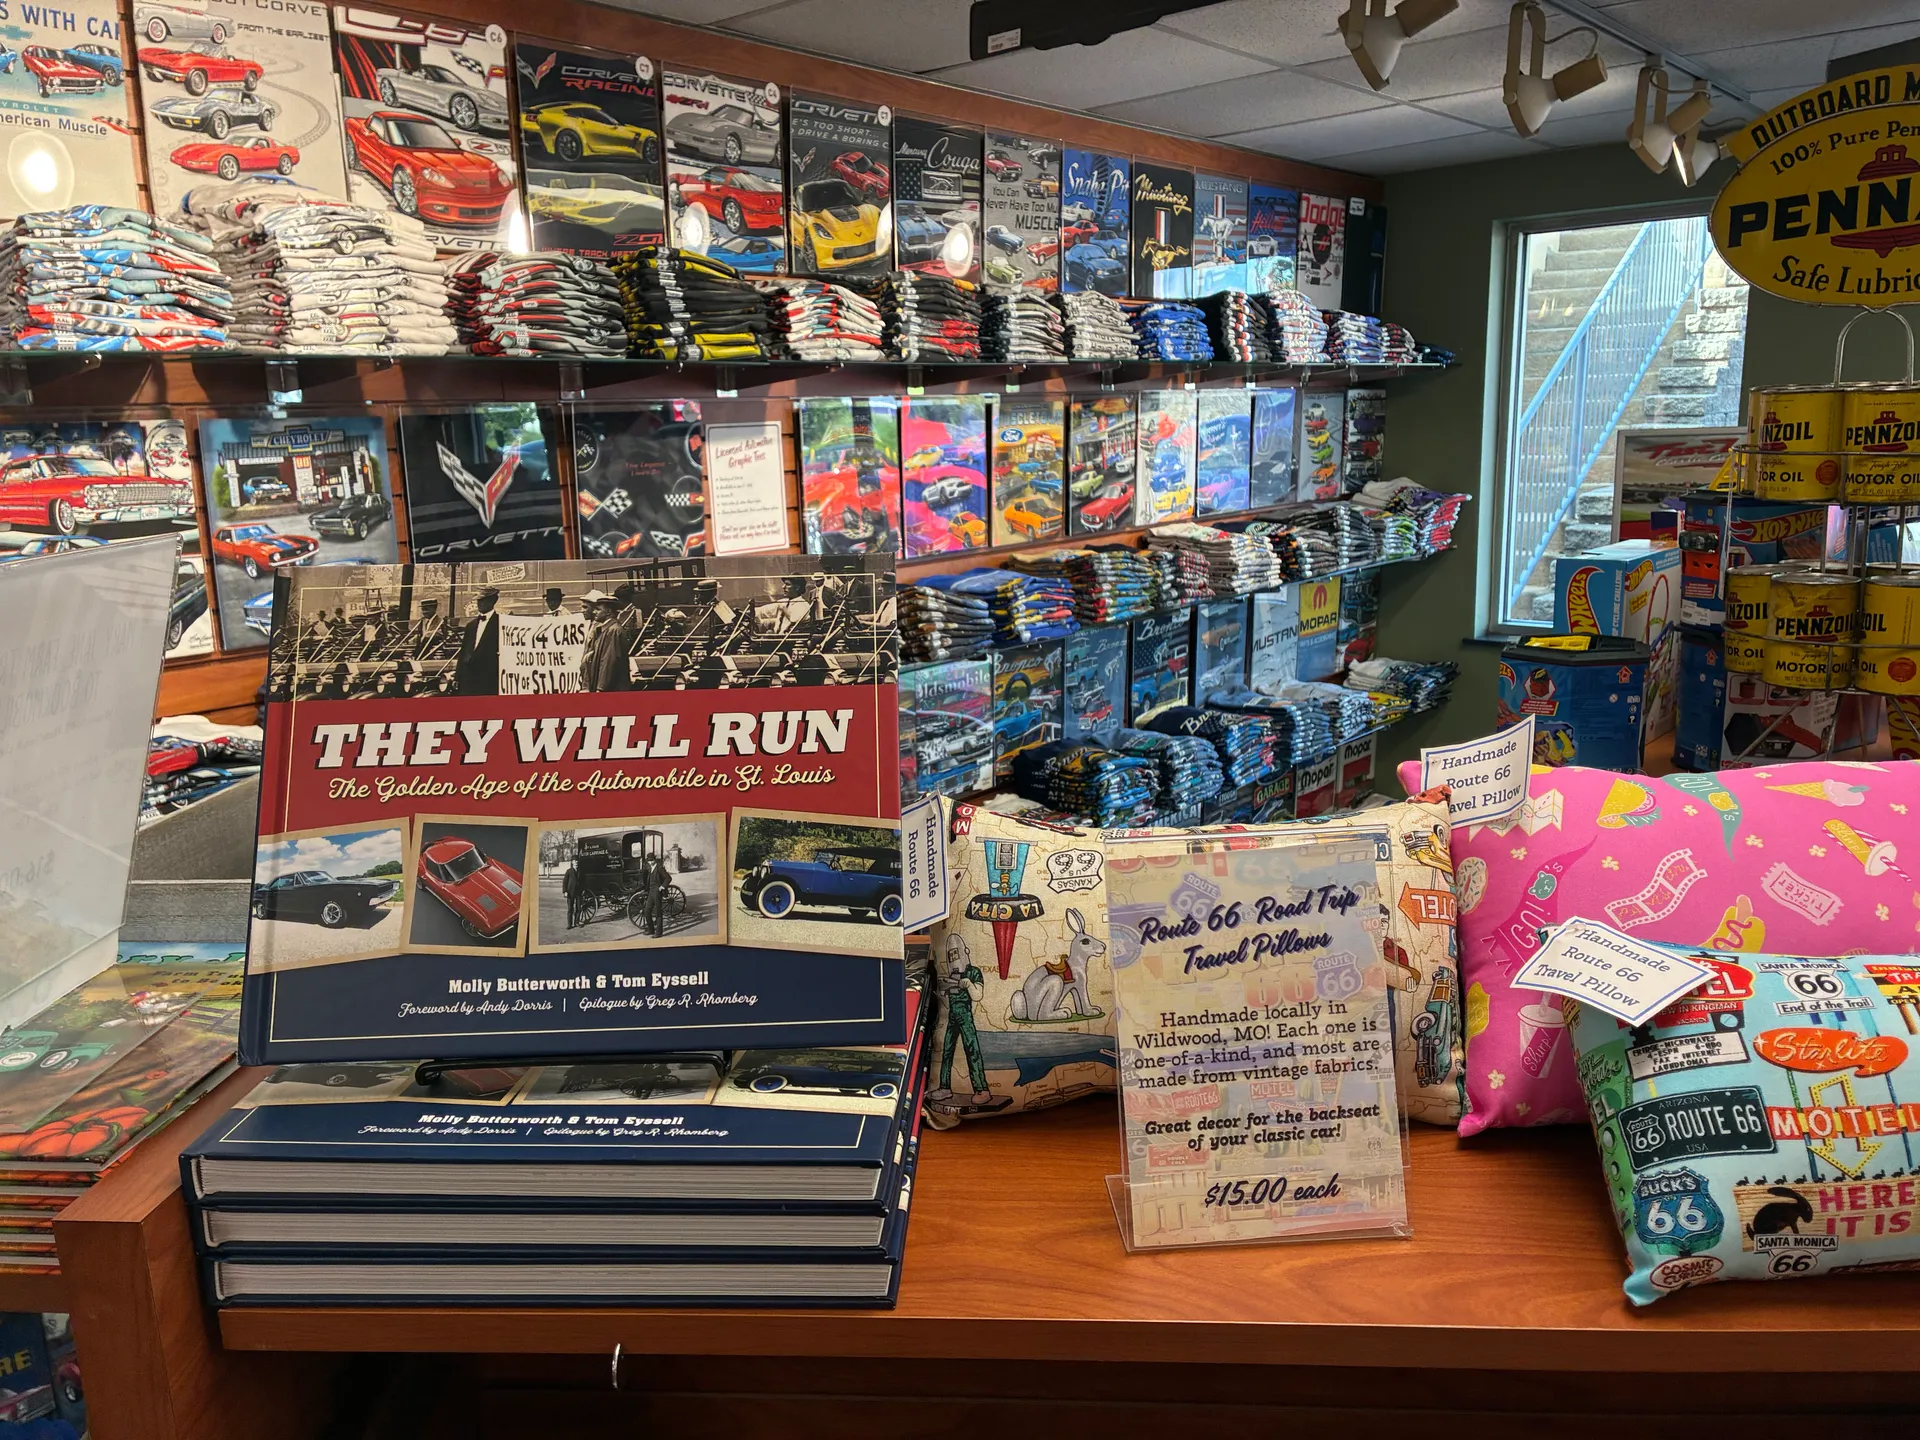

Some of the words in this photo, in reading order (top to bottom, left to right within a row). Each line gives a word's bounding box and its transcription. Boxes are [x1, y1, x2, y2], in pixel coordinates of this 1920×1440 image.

[21, 4, 76, 31] WITH
[237, 23, 264, 32] FROM
[266, 27, 283, 36] THE
[663, 73, 751, 102] CORVETTE
[1751, 75, 1890, 149] OUTBOARD
[58, 118, 108, 135] Muscle
[798, 129, 829, 139] DRIVE
[842, 136, 879, 147] BORING
[813, 121, 833, 130] TOO
[1770, 141, 1822, 175] 100%
[1829, 126, 1879, 151] Pure
[1006, 188, 1020, 197] Can
[1063, 162, 1105, 199] Snake
[1107, 169, 1130, 200] Pit
[1195, 180, 1243, 193] MUSTANG
[1010, 201, 1029, 211] Have
[1031, 202, 1045, 212] Too
[1727, 177, 1920, 248] PENN
[1772, 254, 1831, 292] Safe
[716, 441, 743, 458] Licensed
[1780, 471, 1804, 482] OIL
[1846, 473, 1895, 484] MOTOR
[1300, 612, 1337, 631] MOPAR
[502, 626, 531, 646] THESE
[532, 623, 552, 648] 14
[554, 623, 585, 645] CARS
[516, 652, 533, 666] SOLD
[536, 652, 545, 666] TO
[548, 652, 565, 666] THE
[1775, 660, 1826, 673] MOTOR
[1861, 661, 1878, 674] OIL
[501, 669, 519, 694] CITY
[522, 677, 529, 690] OF
[311, 720, 503, 768] THEY
[511, 714, 690, 763] WILL
[704, 709, 853, 757] RUN
[1344, 739, 1371, 760] Mopar
[1442, 741, 1517, 771] Handmade
[329, 777, 371, 799] The
[375, 775, 457, 803] Golden
[460, 774, 510, 800] Age
[513, 772, 537, 798] of
[539, 772, 573, 792] the
[577, 767, 706, 796] Automobile
[709, 769, 731, 787] in
[735, 764, 765, 792] St.
[771, 763, 835, 785] Louis
[1300, 763, 1334, 790] Mopar
[1447, 774, 1489, 790] Route
[1494, 765, 1511, 781] 66
[1256, 778, 1290, 803] GARAGE
[1482, 783, 1521, 807] Pillow
[908, 829, 918, 875] Route
[926, 815, 939, 899] Handmade
[910, 878, 920, 899] 66
[1057, 878, 1093, 889] KANSAS
[1778, 878, 1822, 911] TICKET
[970, 901, 1012, 920] CITA
[1139, 914, 1201, 945] Route
[1207, 902, 1242, 930] 66
[1255, 891, 1312, 924] Road
[1318, 884, 1361, 916] Trip
[1183, 939, 1247, 974] Travel
[1252, 928, 1334, 962] Pillows
[1575, 929, 1671, 973] Handmade
[1562, 946, 1612, 971] Route
[1615, 967, 1643, 983] 66
[448, 979, 492, 996] Molly
[497, 975, 591, 992] Butterworth
[596, 975, 607, 988] &
[612, 974, 646, 988] Tom
[651, 971, 709, 989] Eyssell
[1322, 968, 1355, 991] 66
[1534, 964, 1581, 983] Travel
[1580, 978, 1640, 1007] Pillow
[1794, 974, 1838, 994] 66
[398, 1001, 459, 1018] Foreword
[460, 1001, 474, 1016] by
[475, 999, 510, 1015] Andy
[511, 999, 553, 1012] Dorris
[579, 996, 628, 1012] Epilogue
[629, 996, 645, 1010] by
[645, 995, 676, 1010] Greg
[677, 993, 694, 1008] R.
[695, 992, 759, 1007] Rhomberg
[1160, 1008, 1259, 1028] Handmade
[1265, 1002, 1321, 1022] locally
[1328, 1000, 1348, 1016] in
[1691, 1003, 1737, 1011] KINGMAN
[1781, 1001, 1805, 1013] End
[1810, 1001, 1822, 1010] of
[1825, 1000, 1843, 1009] the
[1848, 998, 1871, 1008] Trail
[1134, 1028, 1227, 1049] Wildwood,
[1234, 1025, 1271, 1042] MO!
[1278, 1022, 1318, 1039] Each
[1326, 1023, 1356, 1034] one
[1363, 1017, 1377, 1032] is
[1134, 1047, 1257, 1070] one-of-a-kind,
[1263, 1045, 1296, 1060] and
[1303, 1042, 1347, 1056] most
[1352, 1040, 1380, 1052] are
[1772, 1033, 1890, 1065] Starlite
[1139, 1071, 1187, 1089] made
[1193, 1068, 1238, 1085] from
[1242, 1063, 1309, 1083] vintage
[1314, 1057, 1379, 1075] fabrics.
[1653, 1058, 1671, 1066] FAX
[1659, 1095, 1710, 1109] ARIZONA
[1145, 1119, 1192, 1135] Great
[1197, 1114, 1241, 1131] decor
[1246, 1112, 1271, 1130] for
[1276, 1110, 1304, 1124] the
[1309, 1104, 1380, 1122] backseat
[1631, 1120, 1654, 1131] ROUTE
[1665, 1106, 1731, 1140] ROUTE
[1733, 1105, 1761, 1132] 66
[1188, 1135, 1206, 1152] of
[1210, 1133, 1249, 1150] your
[1253, 1129, 1306, 1144] classic
[1310, 1123, 1342, 1139] car!
[1636, 1129, 1660, 1149] 66
[1686, 1143, 1709, 1152] USA
[1204, 1177, 1288, 1207] $15.00
[1293, 1171, 1342, 1200] each
[1640, 1177, 1696, 1196] BUCK'S
[1818, 1181, 1915, 1213] HERE
[1647, 1197, 1707, 1234] 66
[1826, 1216, 1864, 1238] IT
[1874, 1211, 1912, 1235] IS
[1758, 1236, 1791, 1249] SANTA
[1794, 1236, 1836, 1247] MONICA
[1773, 1255, 1811, 1273] 66
